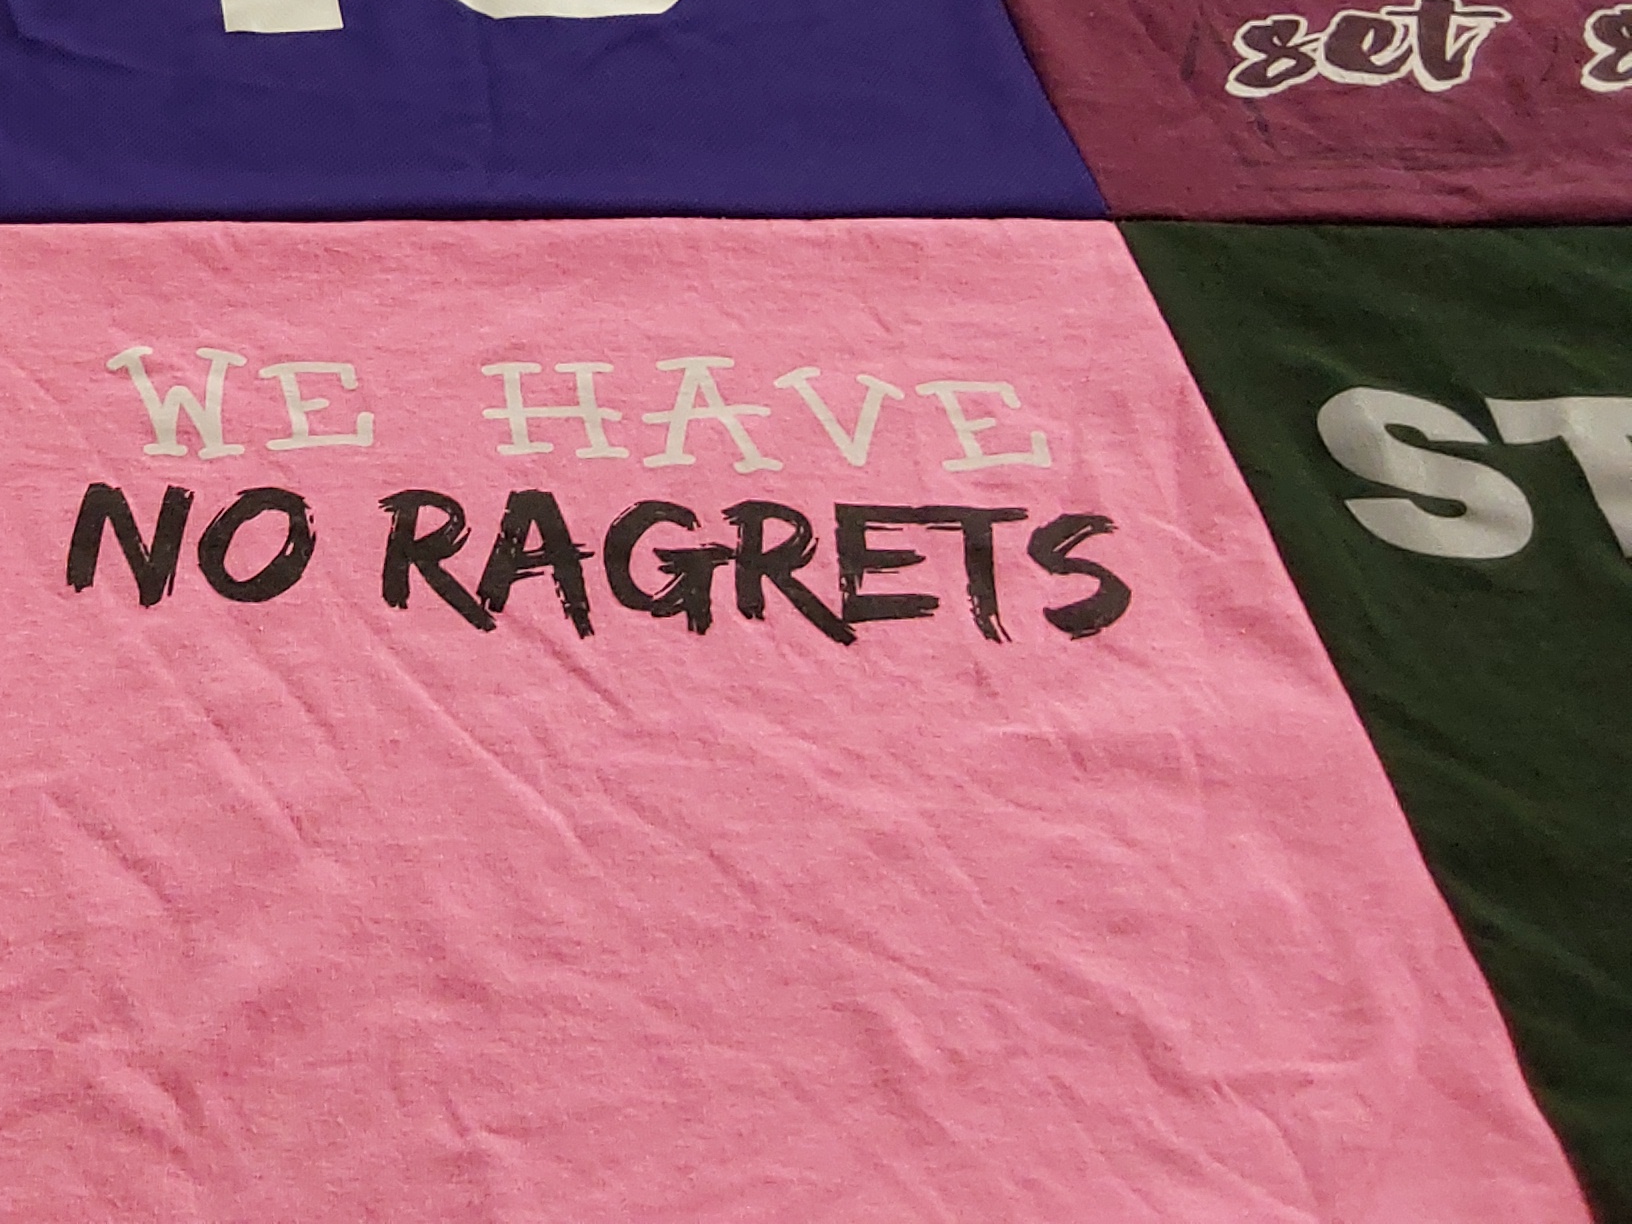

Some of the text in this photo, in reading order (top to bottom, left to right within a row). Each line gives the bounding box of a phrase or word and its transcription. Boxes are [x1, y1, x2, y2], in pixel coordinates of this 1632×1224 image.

[105, 346, 1052, 475] WE HAVE
[64, 481, 1134, 646] NO RAGRETS
